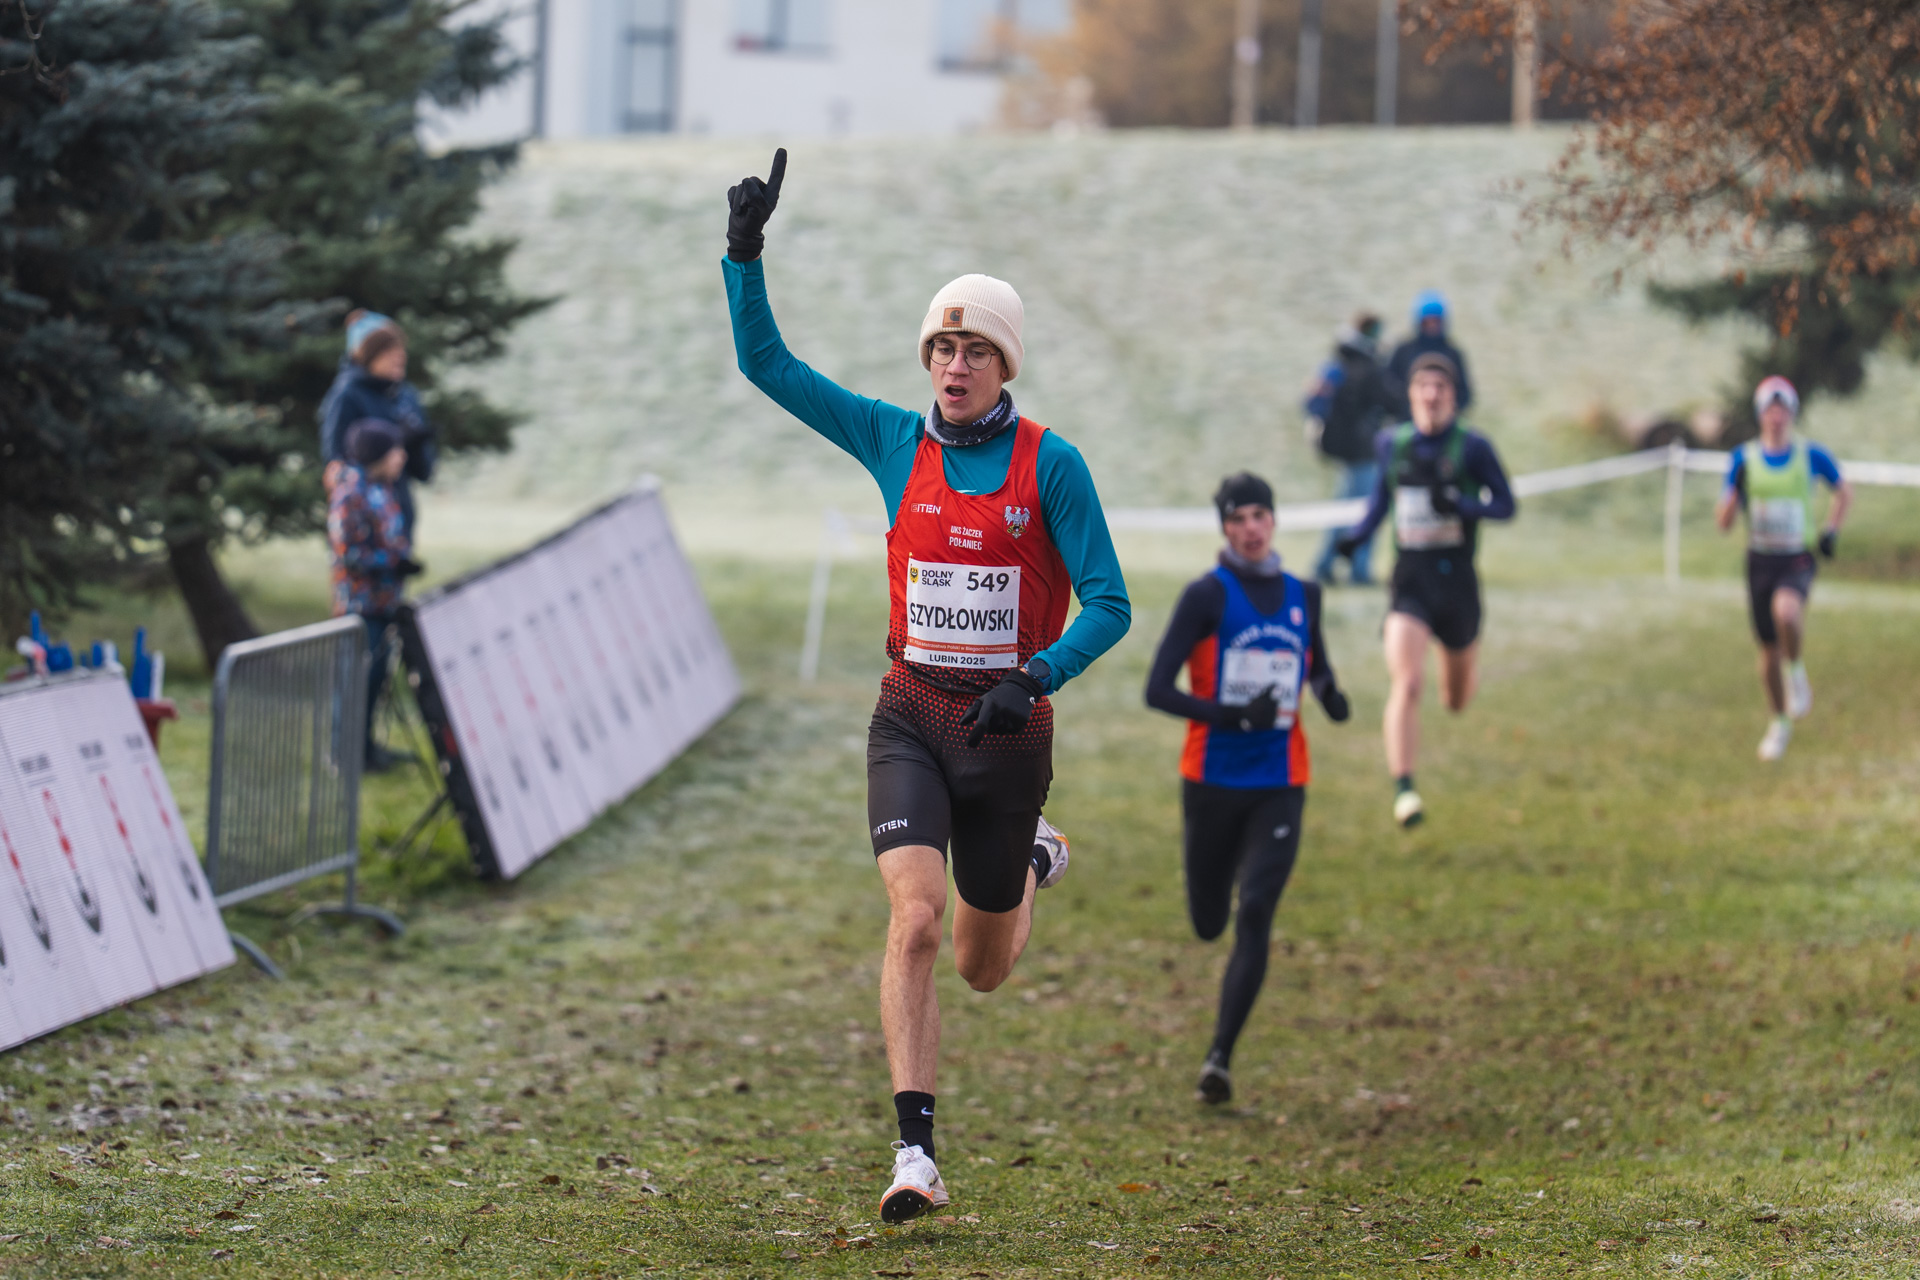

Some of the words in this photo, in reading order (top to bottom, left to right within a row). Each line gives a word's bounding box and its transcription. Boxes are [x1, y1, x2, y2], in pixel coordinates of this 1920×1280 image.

[950, 525, 962, 535] UKS
[962, 526, 983, 538] ŻACZEK
[949, 536, 982, 551] POŁANIEC
[922, 569, 954, 579] DOLNY
[966, 572, 1009, 592] 549
[910, 602, 1014, 631] SZYDŁOWSKI
[929, 654, 958, 664] LUBIN
[960, 657, 985, 665] 2025
